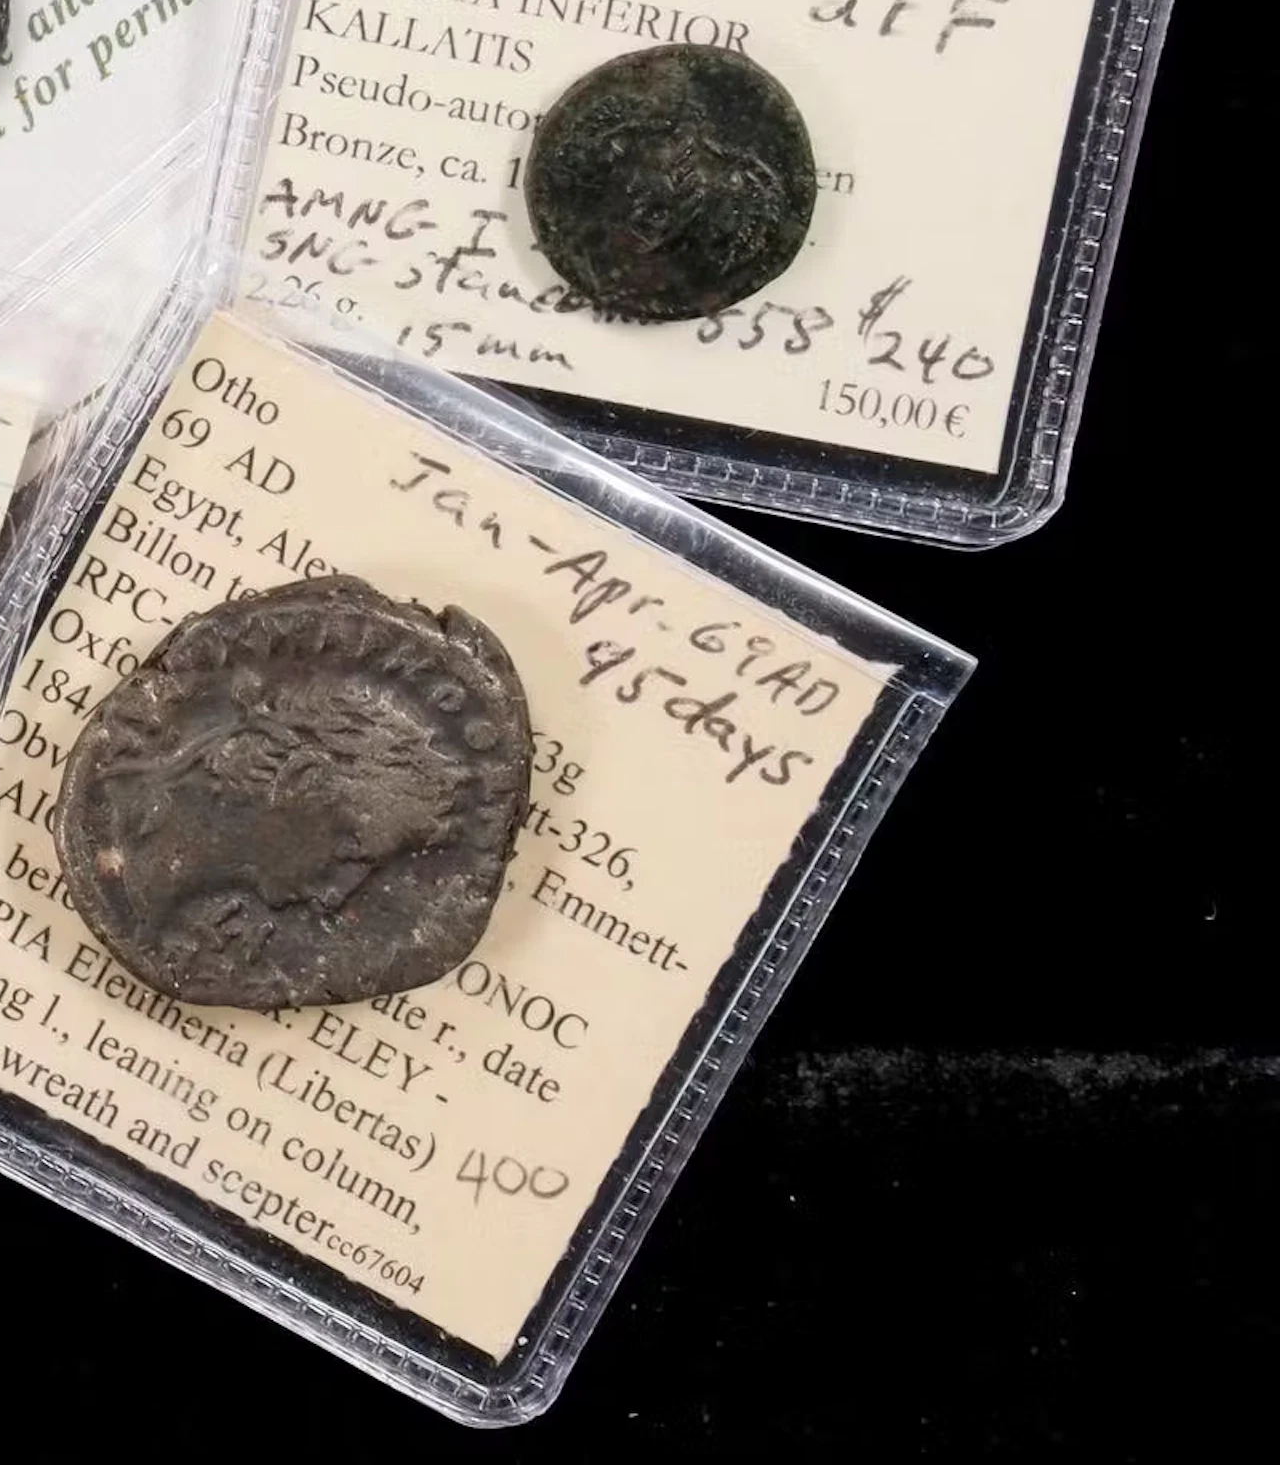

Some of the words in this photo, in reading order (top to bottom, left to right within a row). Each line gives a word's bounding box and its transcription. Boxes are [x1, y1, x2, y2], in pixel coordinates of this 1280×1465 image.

[13, 57, 74, 133] for
[279, 107, 425, 179] Bronze,
[439, 151, 490, 190] ca.
[188, 355, 282, 427] Otho
[814, 374, 939, 436] 150,00
[158, 406, 212, 452] 69
[228, 439, 299, 498] AD
[100, 505, 220, 580] Billon
[129, 453, 248, 548] Egypt,
[529, 864, 690, 975] Emmett-
[64, 945, 253, 1069] Eleutheria
[255, 1050, 439, 1173] (Libertas)
[307, 1008, 433, 1095] ELEY
[481, 1042, 565, 1104] date
[0, 1043, 123, 1131] wreath
[126, 1110, 194, 1169] and
[83, 1017, 220, 1121] leaning
[224, 1100, 279, 1148] on
[280, 1135, 425, 1236] column,
